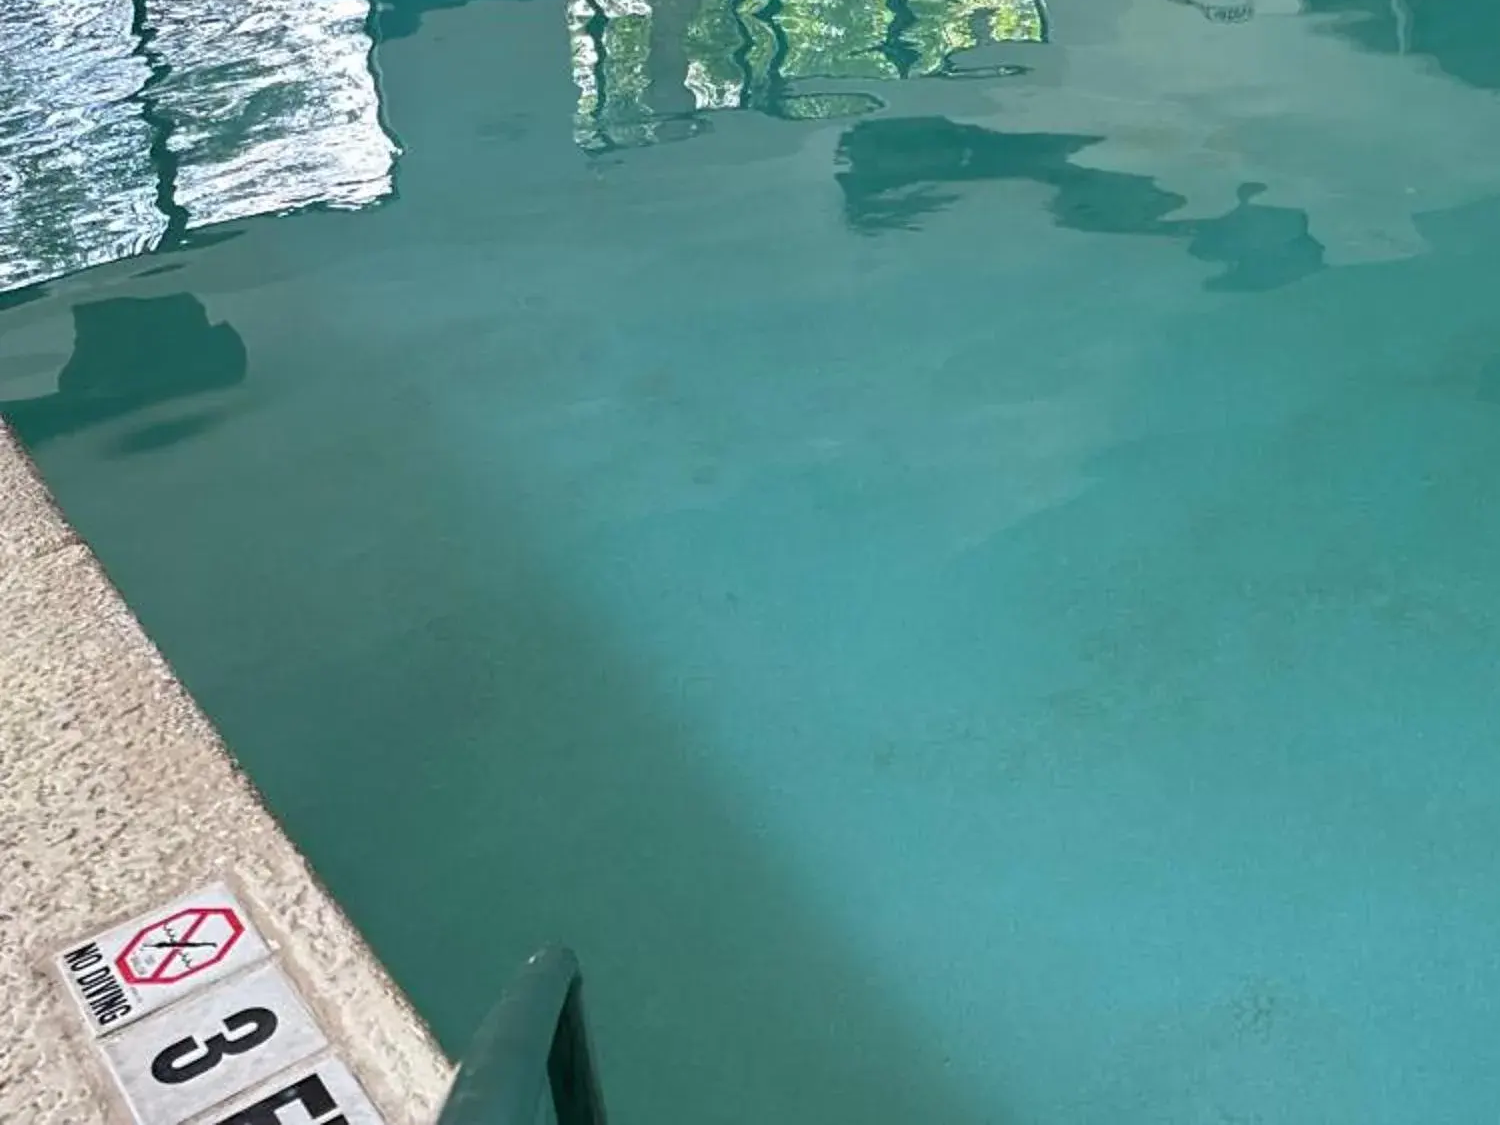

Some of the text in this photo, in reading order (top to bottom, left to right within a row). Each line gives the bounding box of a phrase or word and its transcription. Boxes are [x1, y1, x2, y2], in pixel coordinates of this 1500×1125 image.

[63, 942, 132, 1026] NO DIVING
[151, 1007, 351, 1125] 3 F
